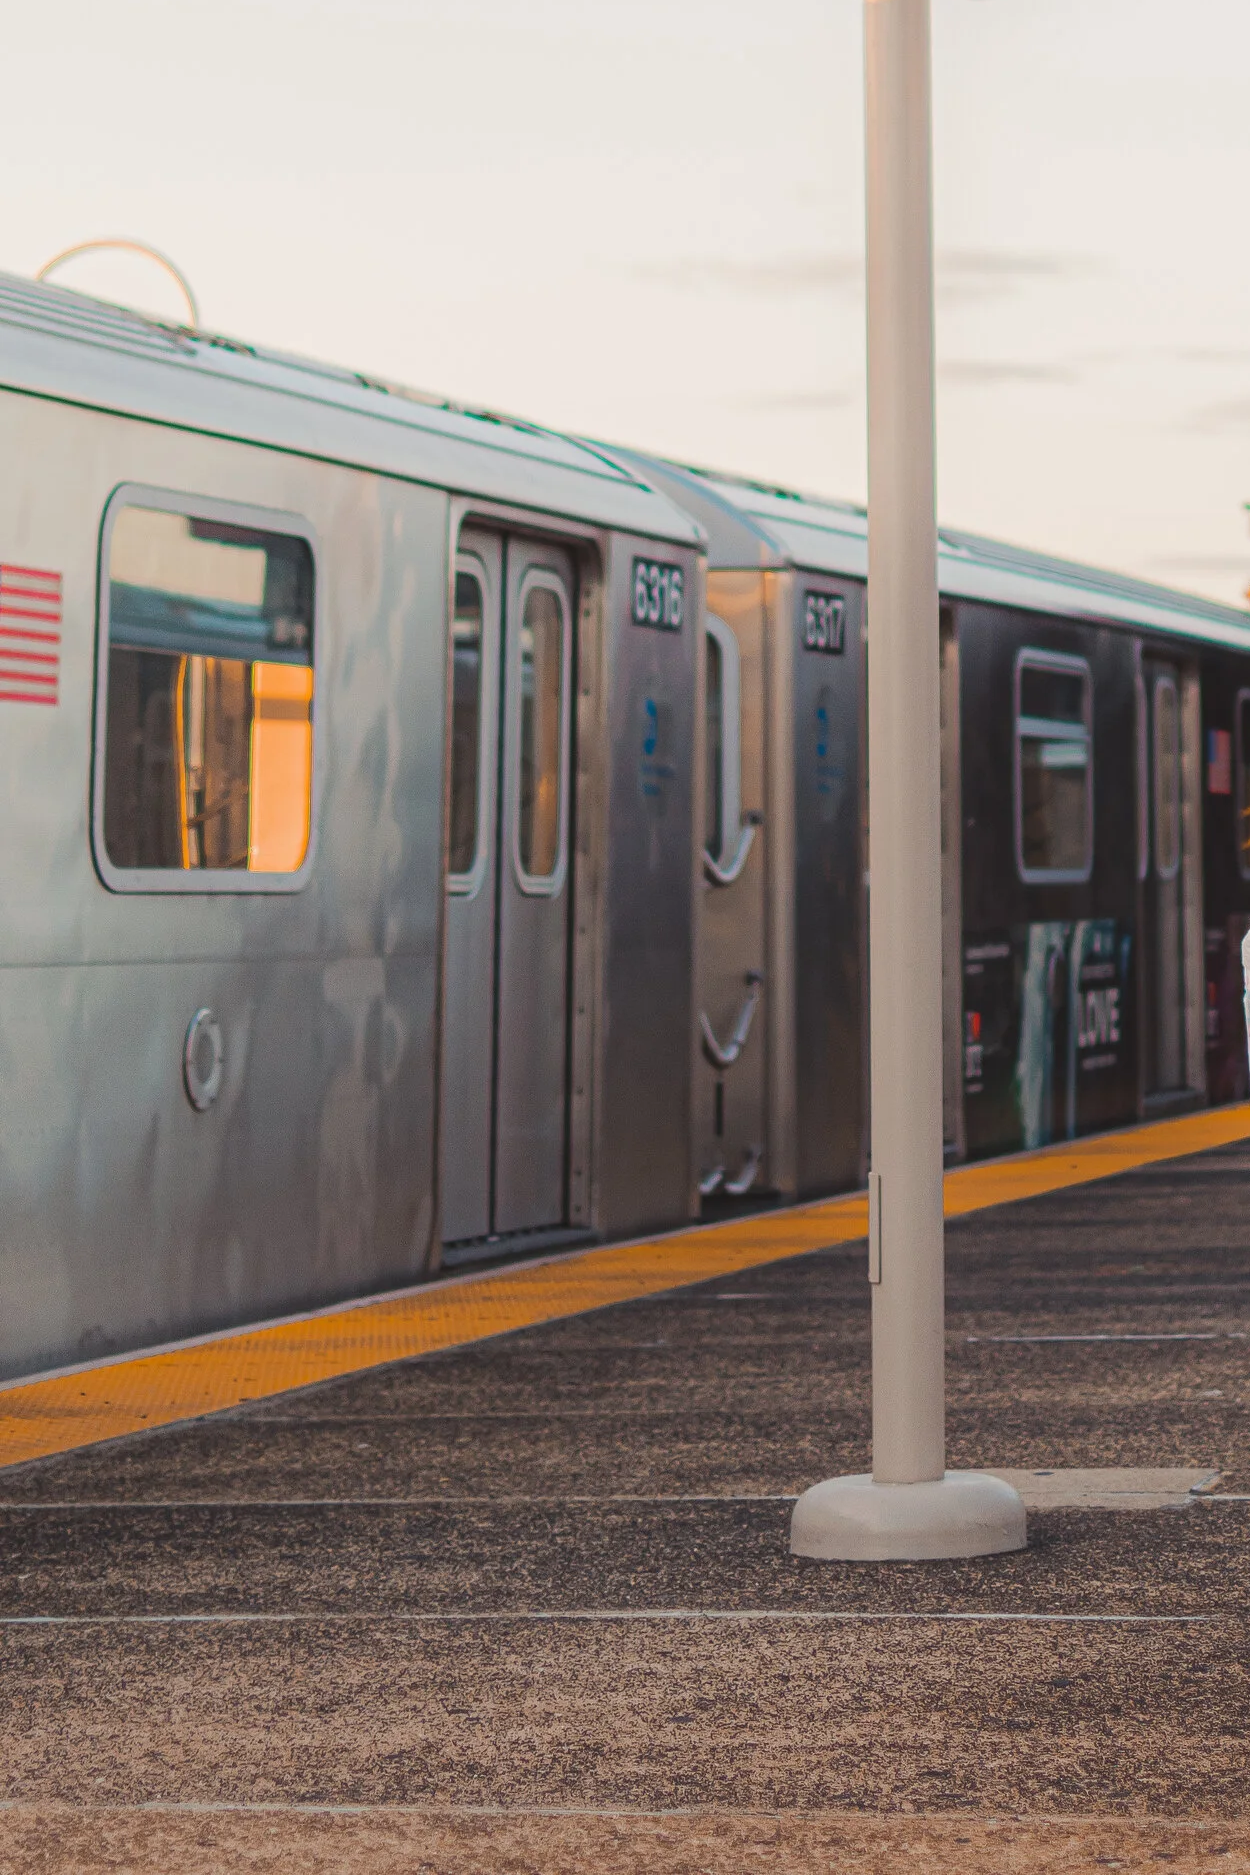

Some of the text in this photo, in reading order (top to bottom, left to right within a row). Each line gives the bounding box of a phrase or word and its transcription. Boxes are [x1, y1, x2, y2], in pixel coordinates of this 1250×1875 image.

[635, 563, 683, 626] 6316
[804, 595, 846, 648] 6317
[1077, 987, 1120, 1048] LOVE
